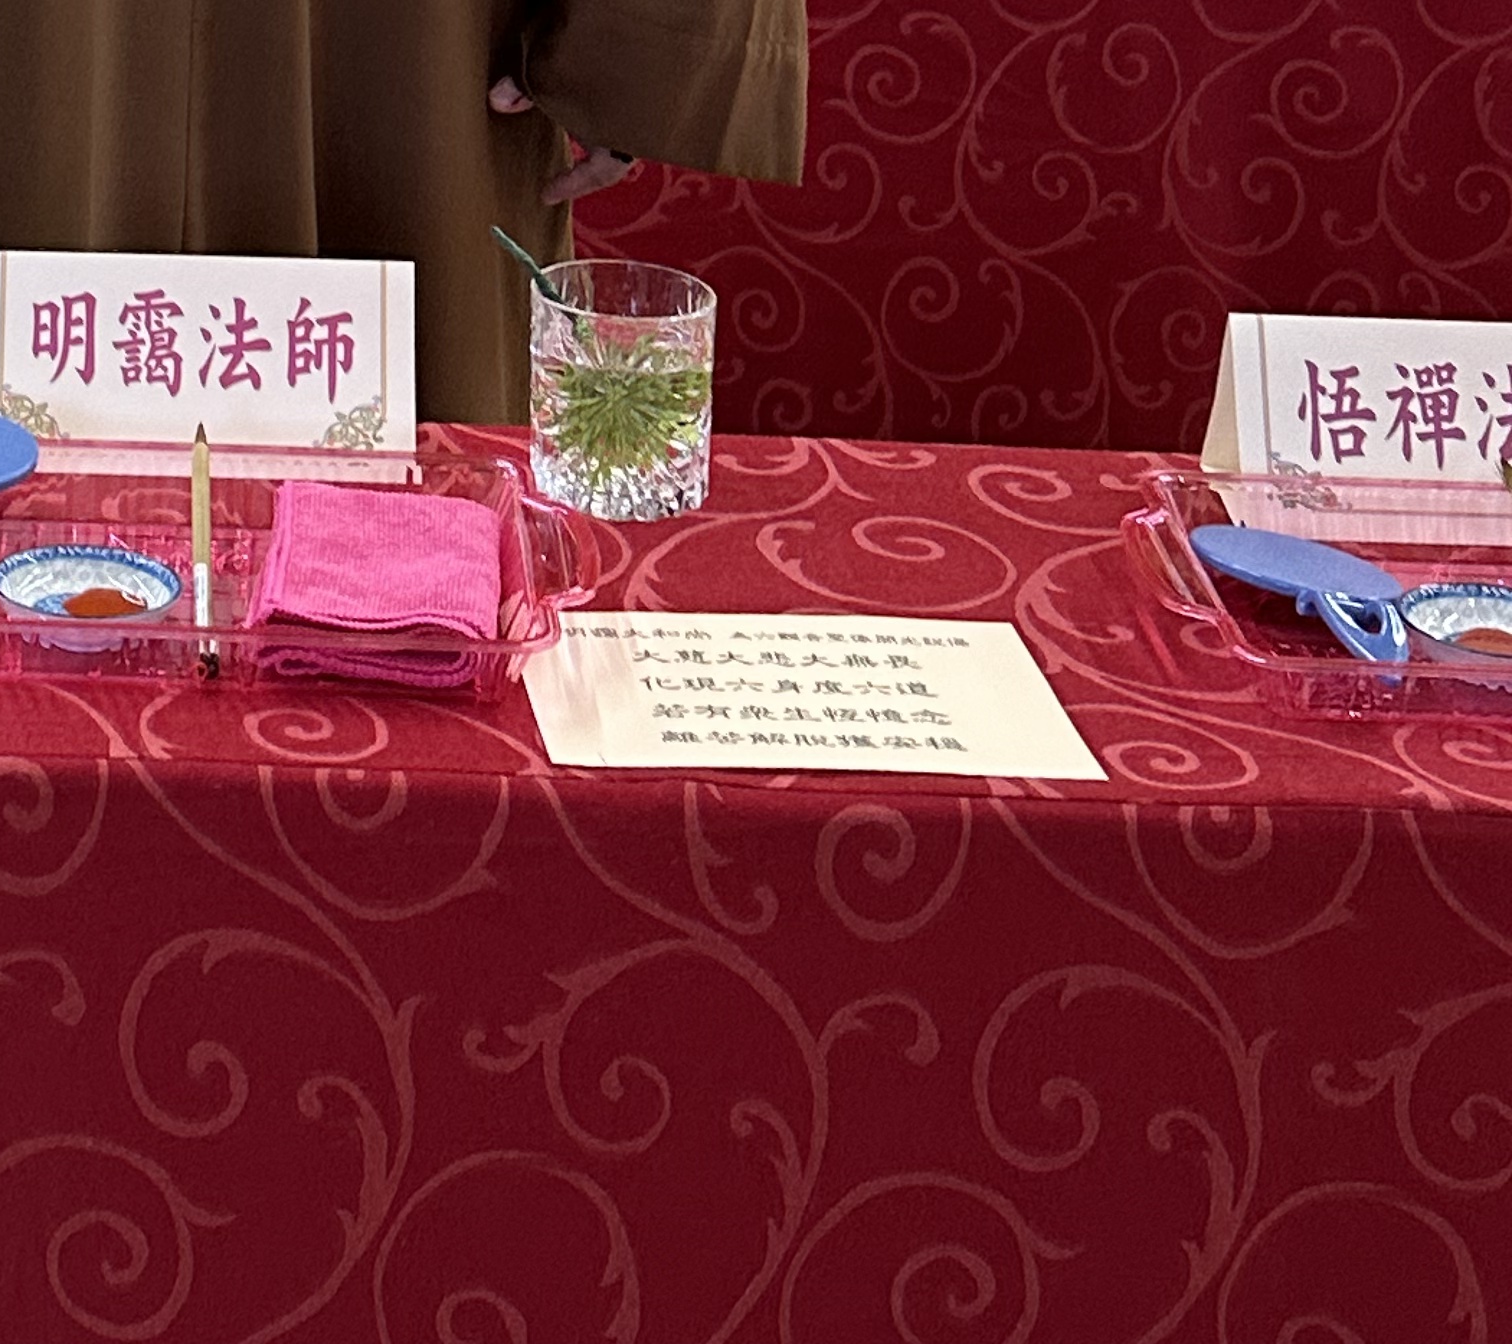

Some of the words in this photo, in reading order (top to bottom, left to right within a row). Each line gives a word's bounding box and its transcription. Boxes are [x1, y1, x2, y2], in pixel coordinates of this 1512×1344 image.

[31, 289, 354, 404] 明靄法師
[640, 676, 939, 698] 化現六身度六道
